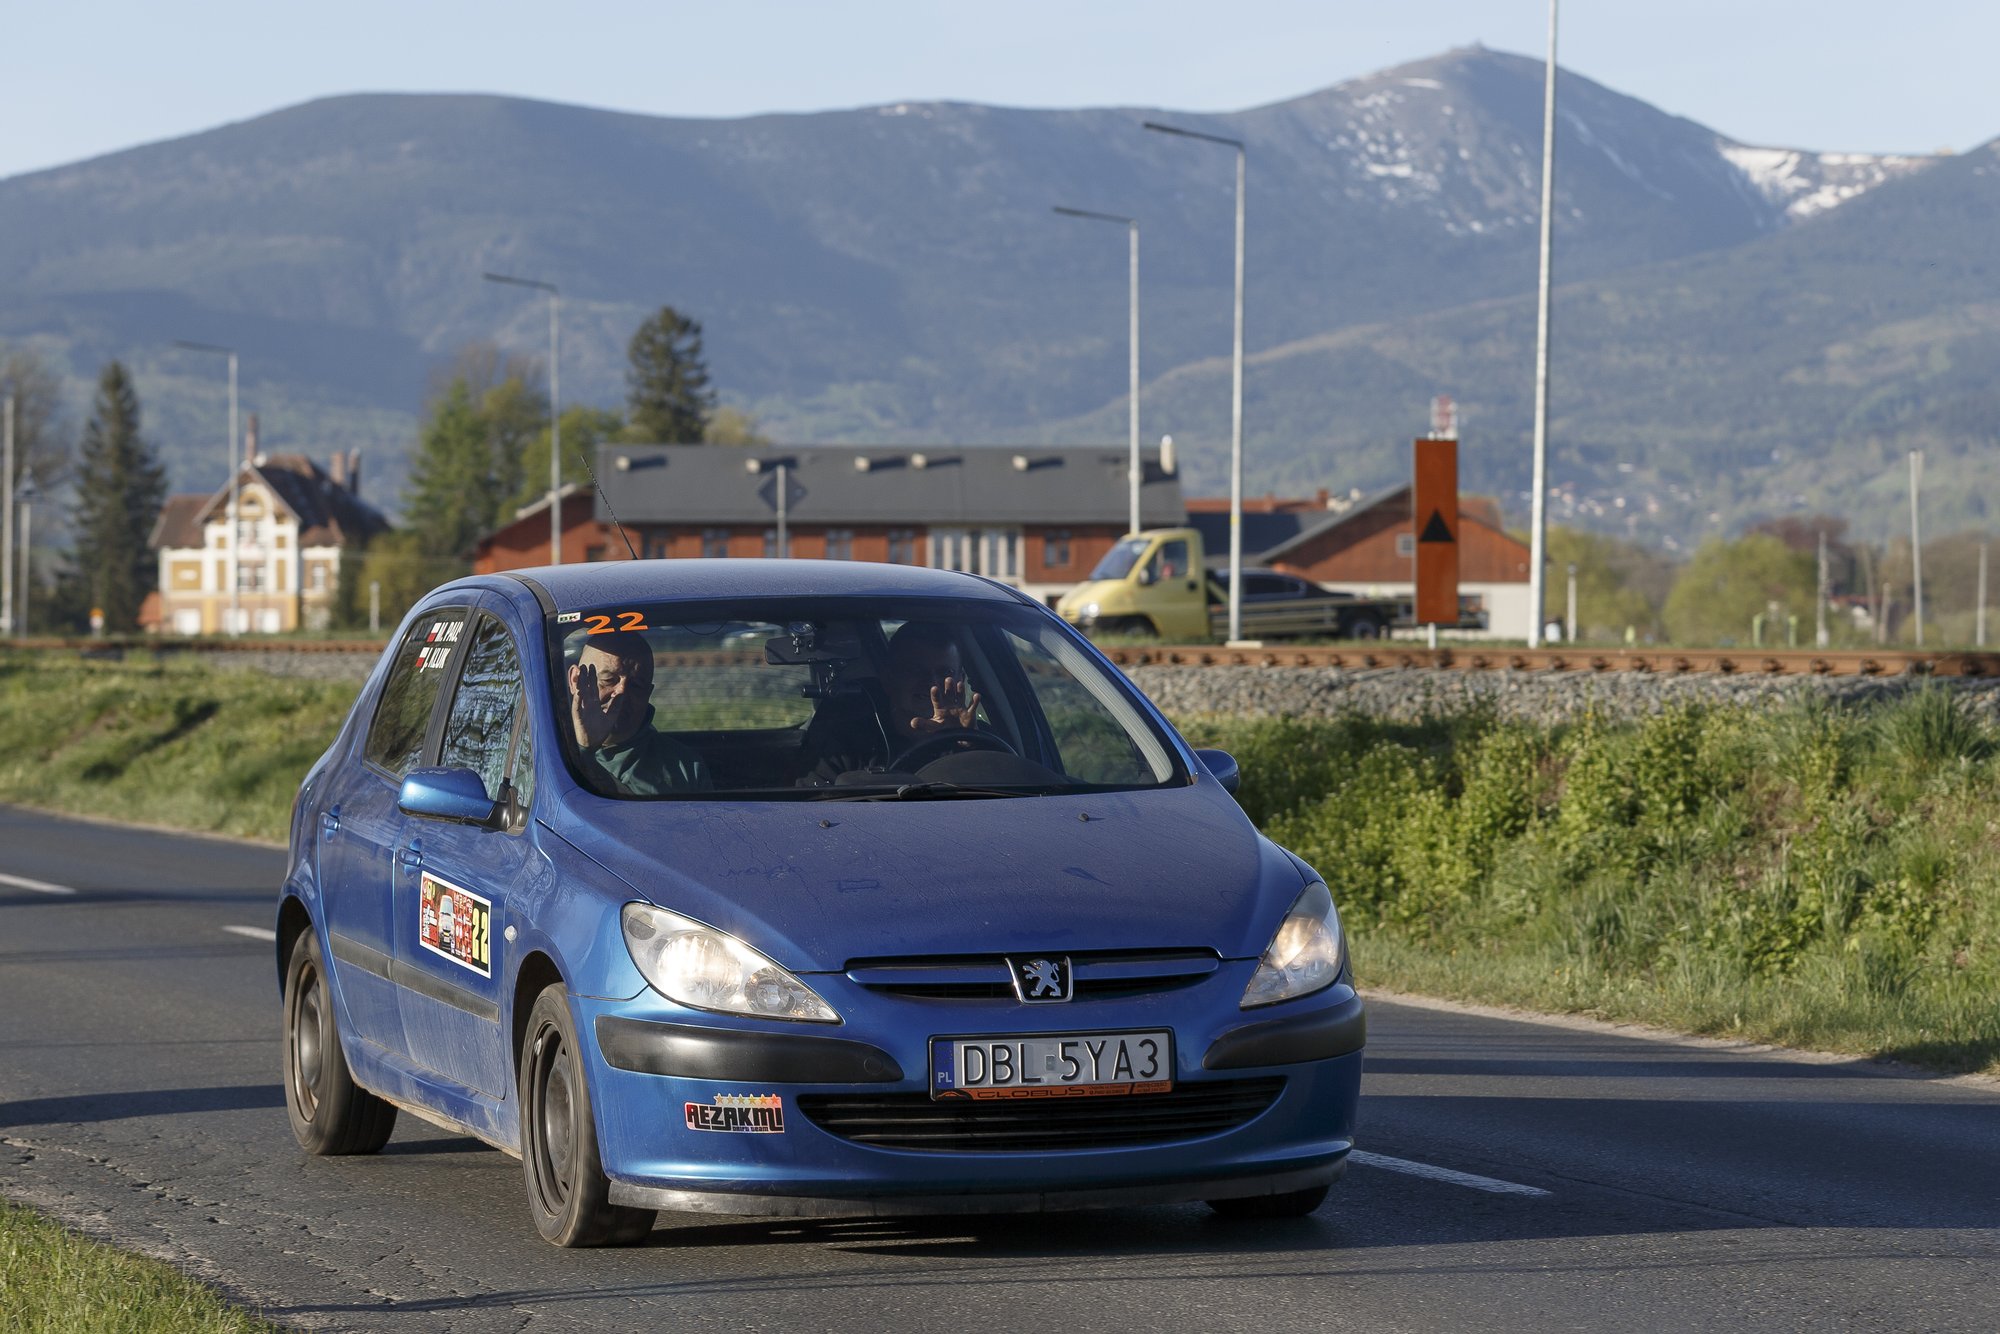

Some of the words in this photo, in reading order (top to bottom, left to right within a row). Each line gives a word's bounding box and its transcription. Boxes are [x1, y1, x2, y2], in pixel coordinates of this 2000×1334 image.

[583, 611, 648, 635] 22
[472, 907, 489, 965] 22
[962, 1042, 1042, 1086] DBL
[1059, 1038, 1159, 1082] 5YA3
[937, 1071, 953, 1083] PL
[686, 1104, 783, 1131] AEZAKMI
